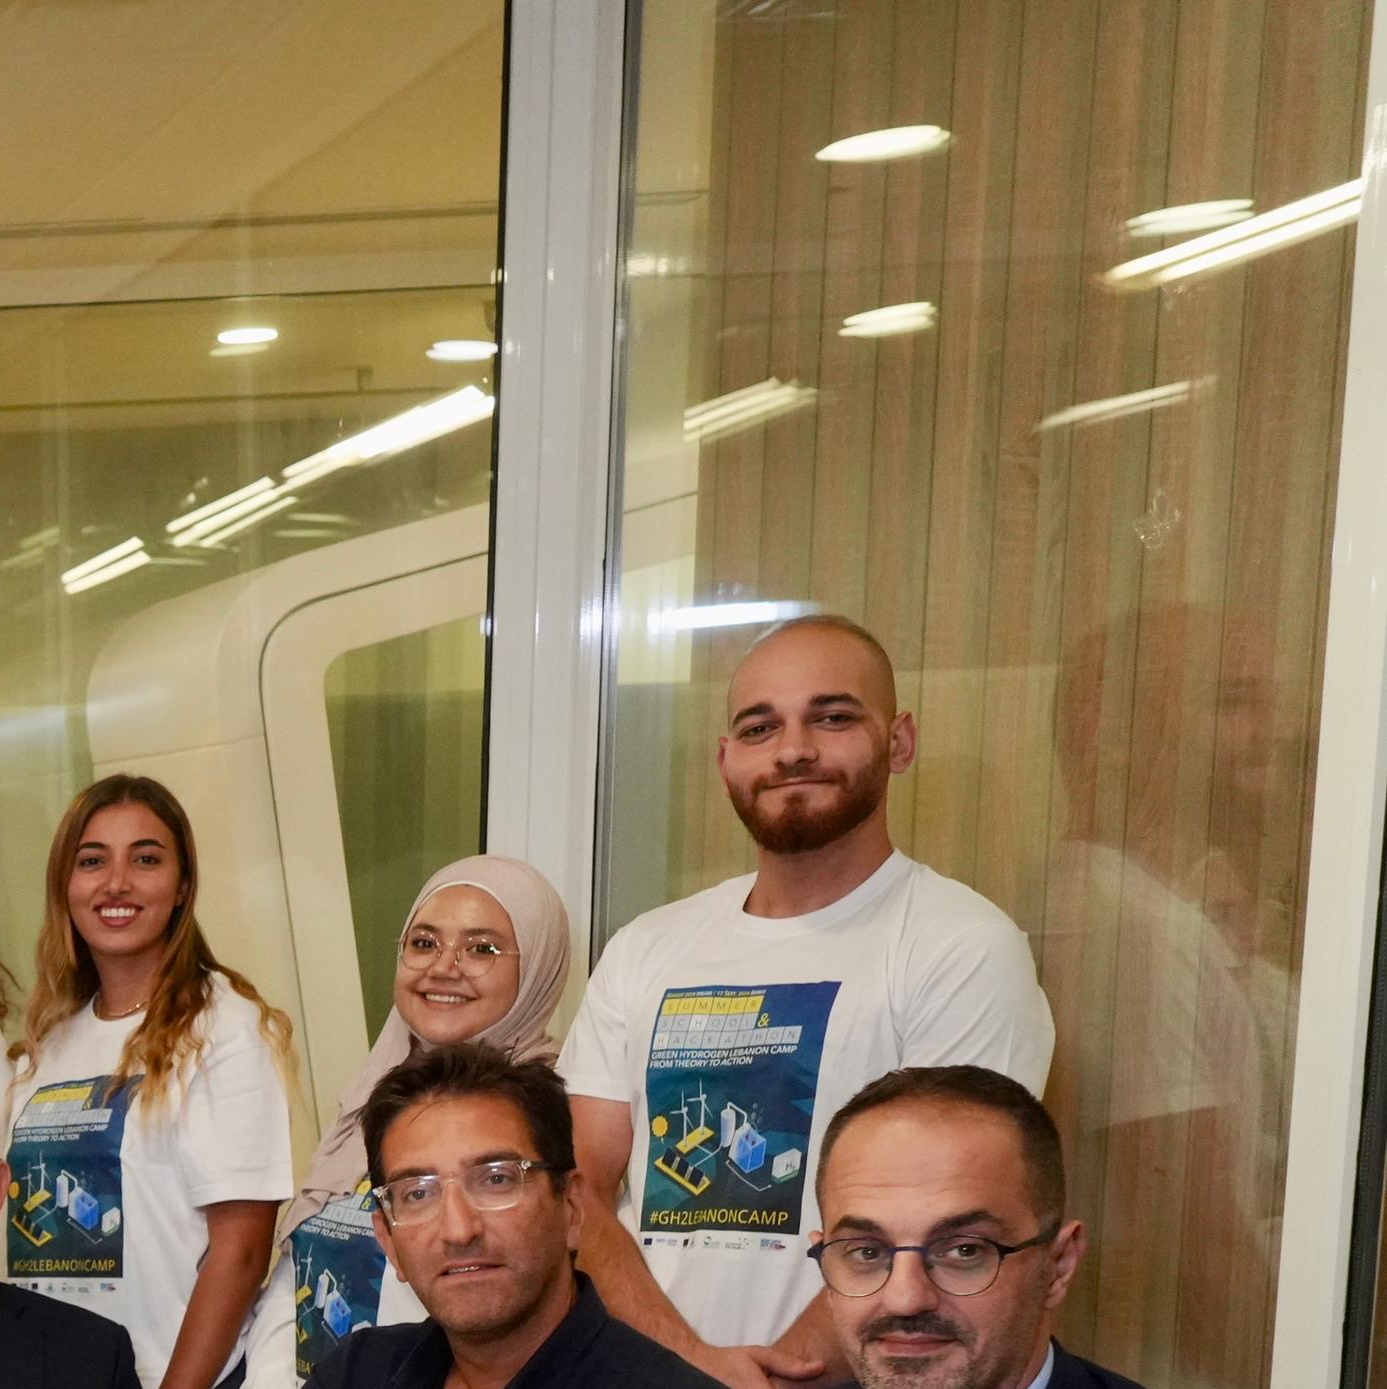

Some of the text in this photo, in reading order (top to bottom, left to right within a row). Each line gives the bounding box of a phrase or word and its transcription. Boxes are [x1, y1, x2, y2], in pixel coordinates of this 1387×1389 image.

[666, 999, 758, 1011] SUMMER
[661, 1012, 770, 1028] SCHOOL &
[657, 1030, 797, 1045] HACKATHON
[651, 1045, 797, 1060] GREEN HYDROGEN LEBANON CAMP
[649, 1056, 754, 1069] FROM THEORY TO ACTION
[88, 1124, 109, 1132] CAMP
[649, 1208, 789, 1226] #GH2LEBANONCAMP
[320, 1228, 329, 1236] TO
[329, 1230, 351, 1241] ACTION
[337, 1222, 362, 1234] LEBANON
[361, 1229, 375, 1237] CAM
